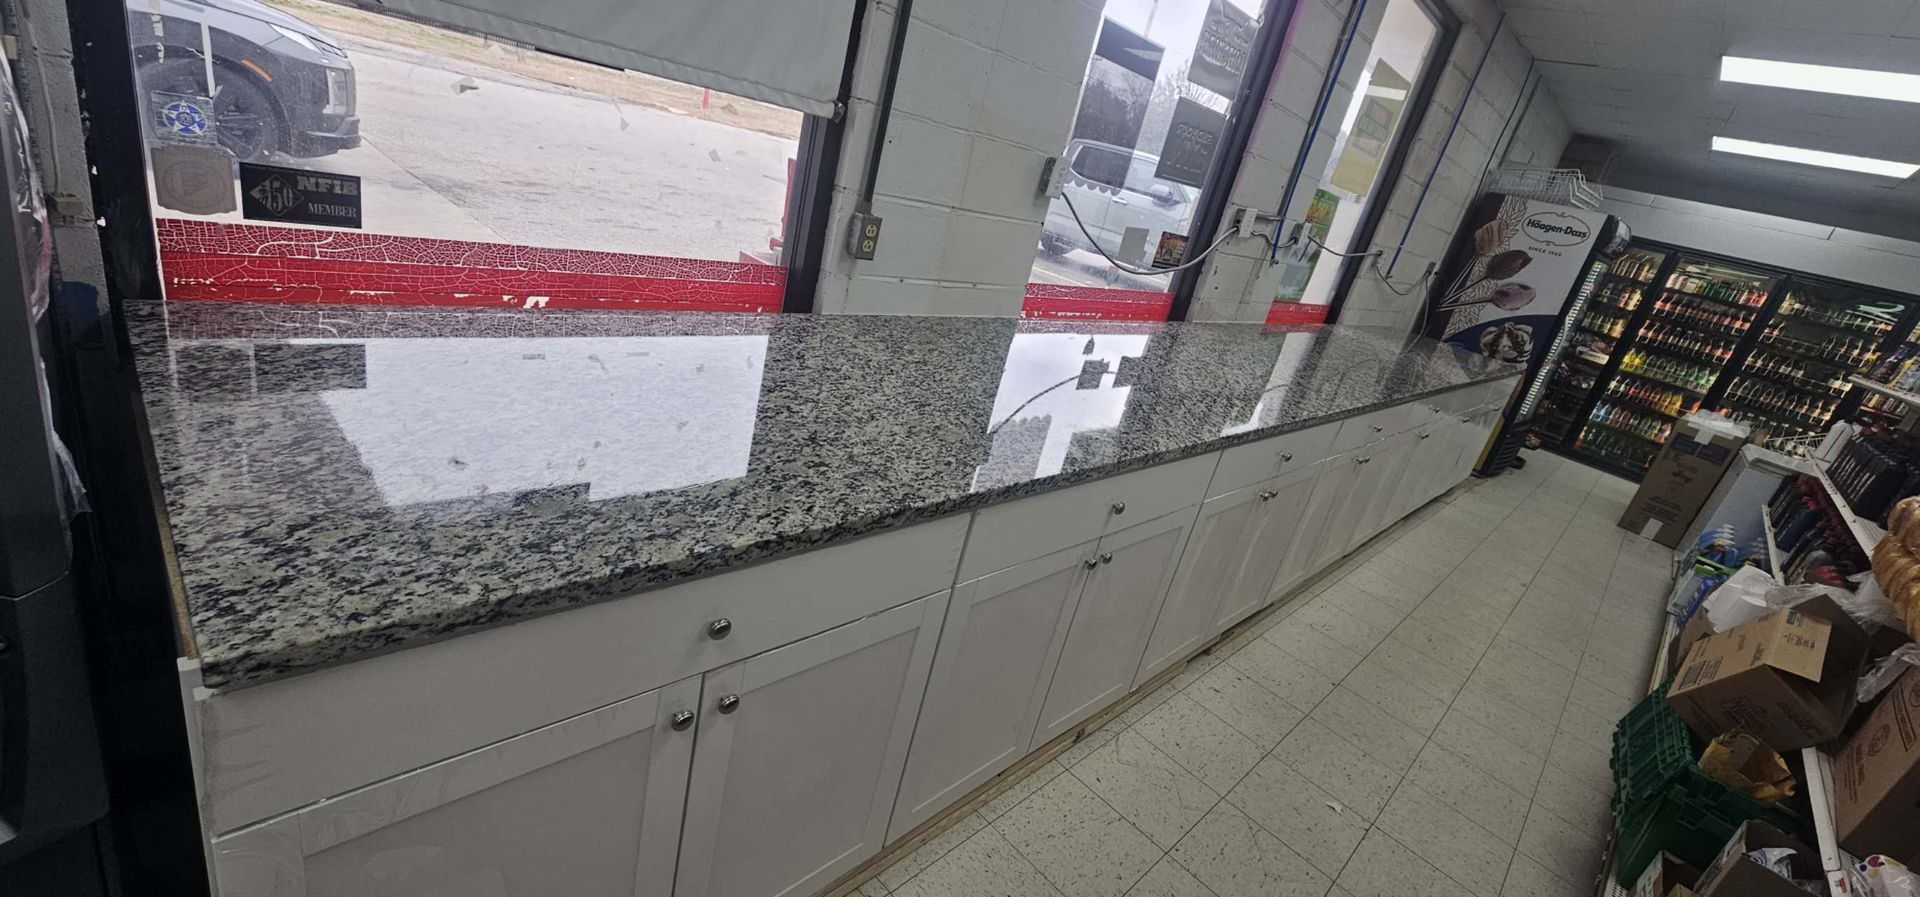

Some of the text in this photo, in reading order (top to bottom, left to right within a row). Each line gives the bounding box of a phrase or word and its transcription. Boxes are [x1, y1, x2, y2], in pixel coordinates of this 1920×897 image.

[296, 176, 358, 195] NFIB
[308, 202, 358, 218] MEMBER
[1527, 218, 1588, 238] Häagen-Dazs
[1528, 245, 1546, 254] SINCE
